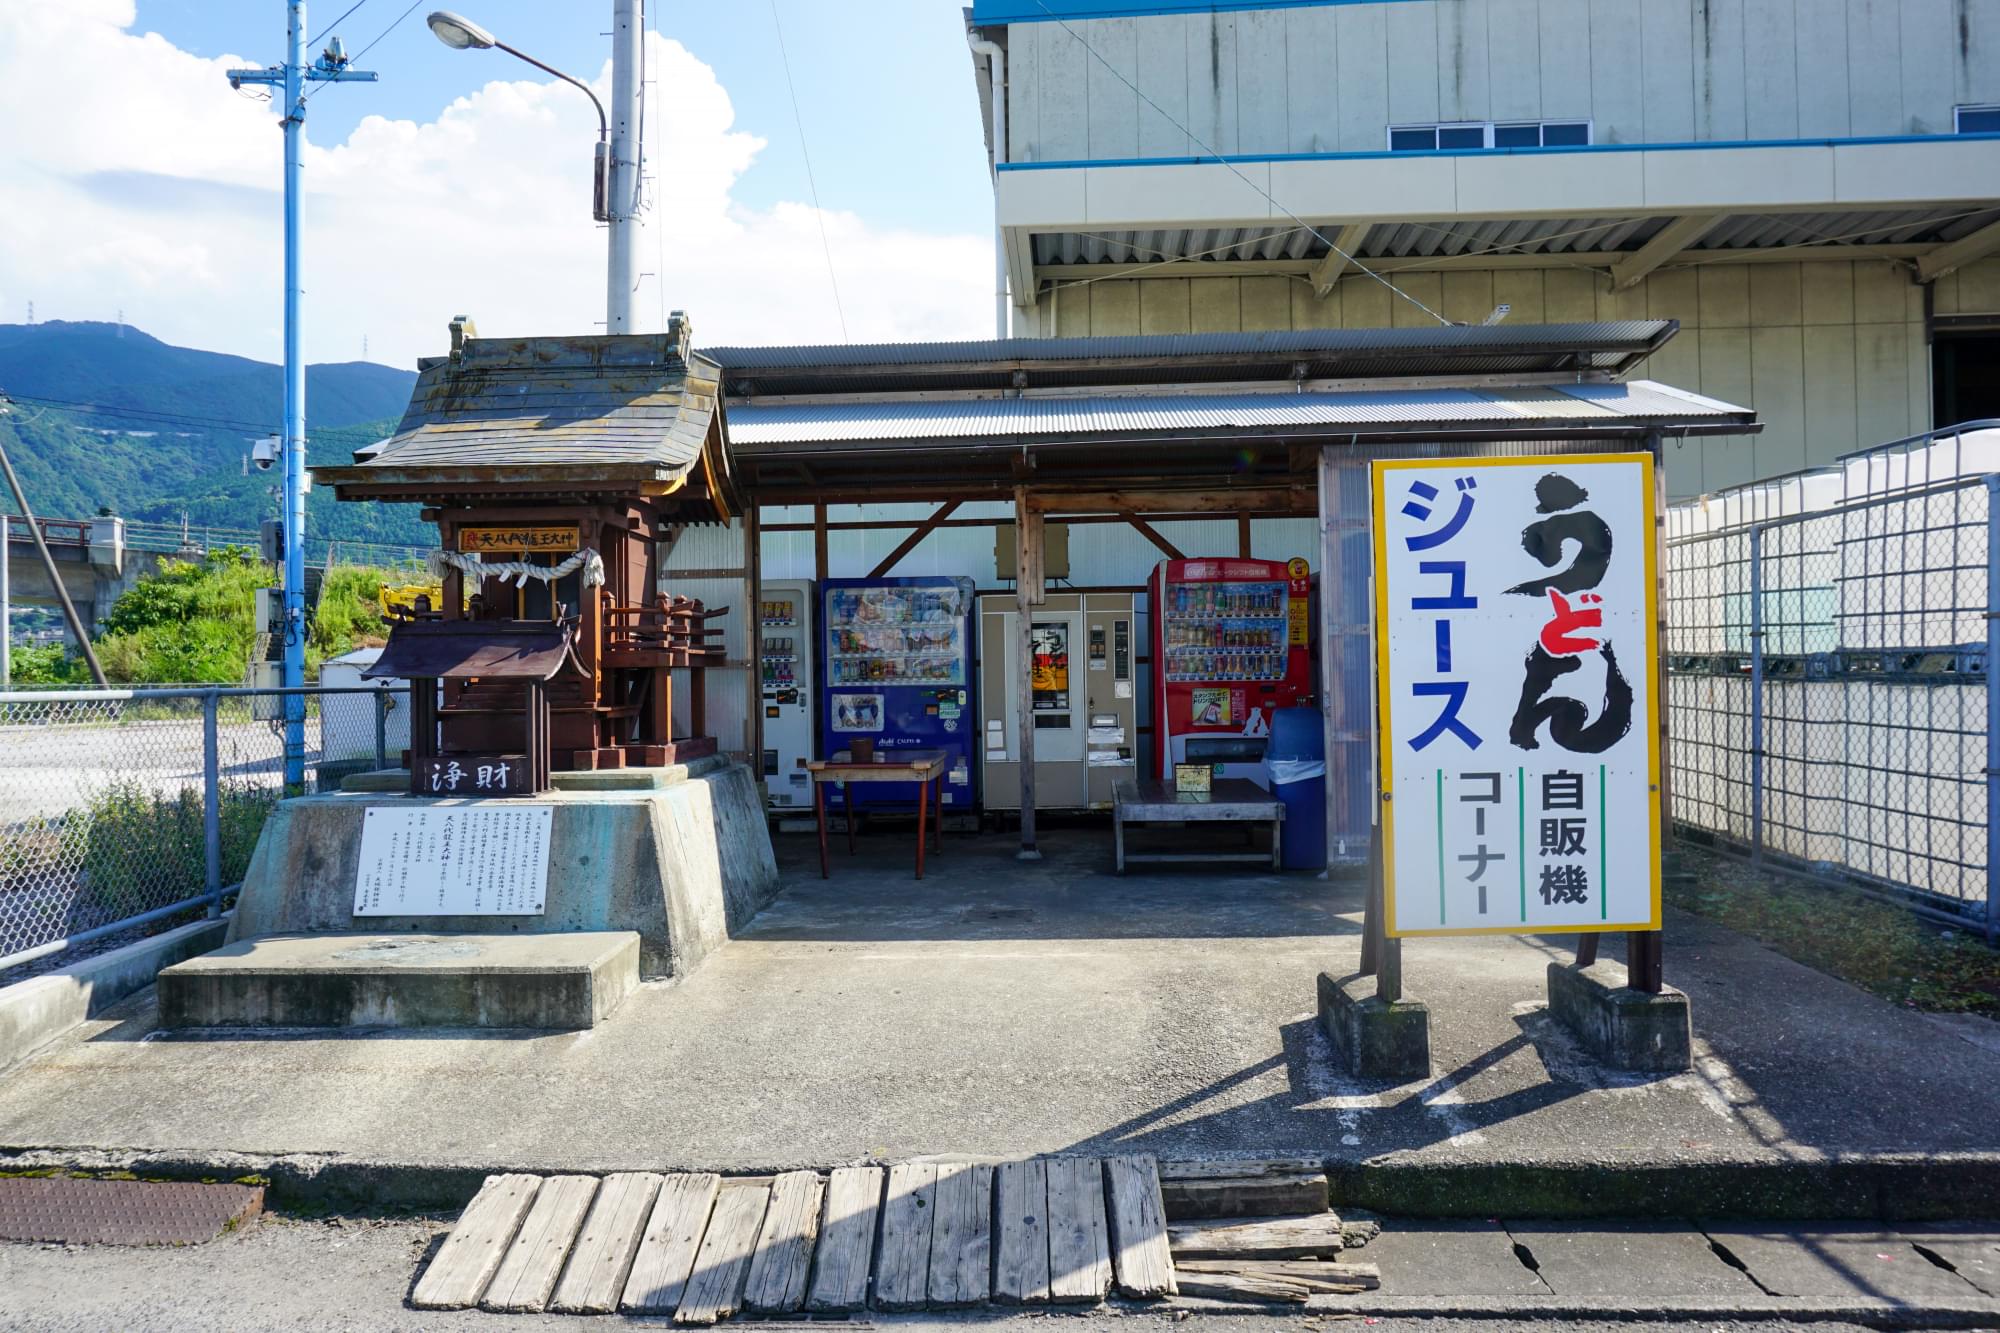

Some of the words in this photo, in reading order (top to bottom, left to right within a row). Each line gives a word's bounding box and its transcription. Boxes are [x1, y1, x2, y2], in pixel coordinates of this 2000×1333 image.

[1401, 476, 1484, 752] ジュース
[1501, 472, 1634, 754] うどん
[1458, 772, 1506, 914] コーナー
[1539, 769, 1588, 906] 自販機
